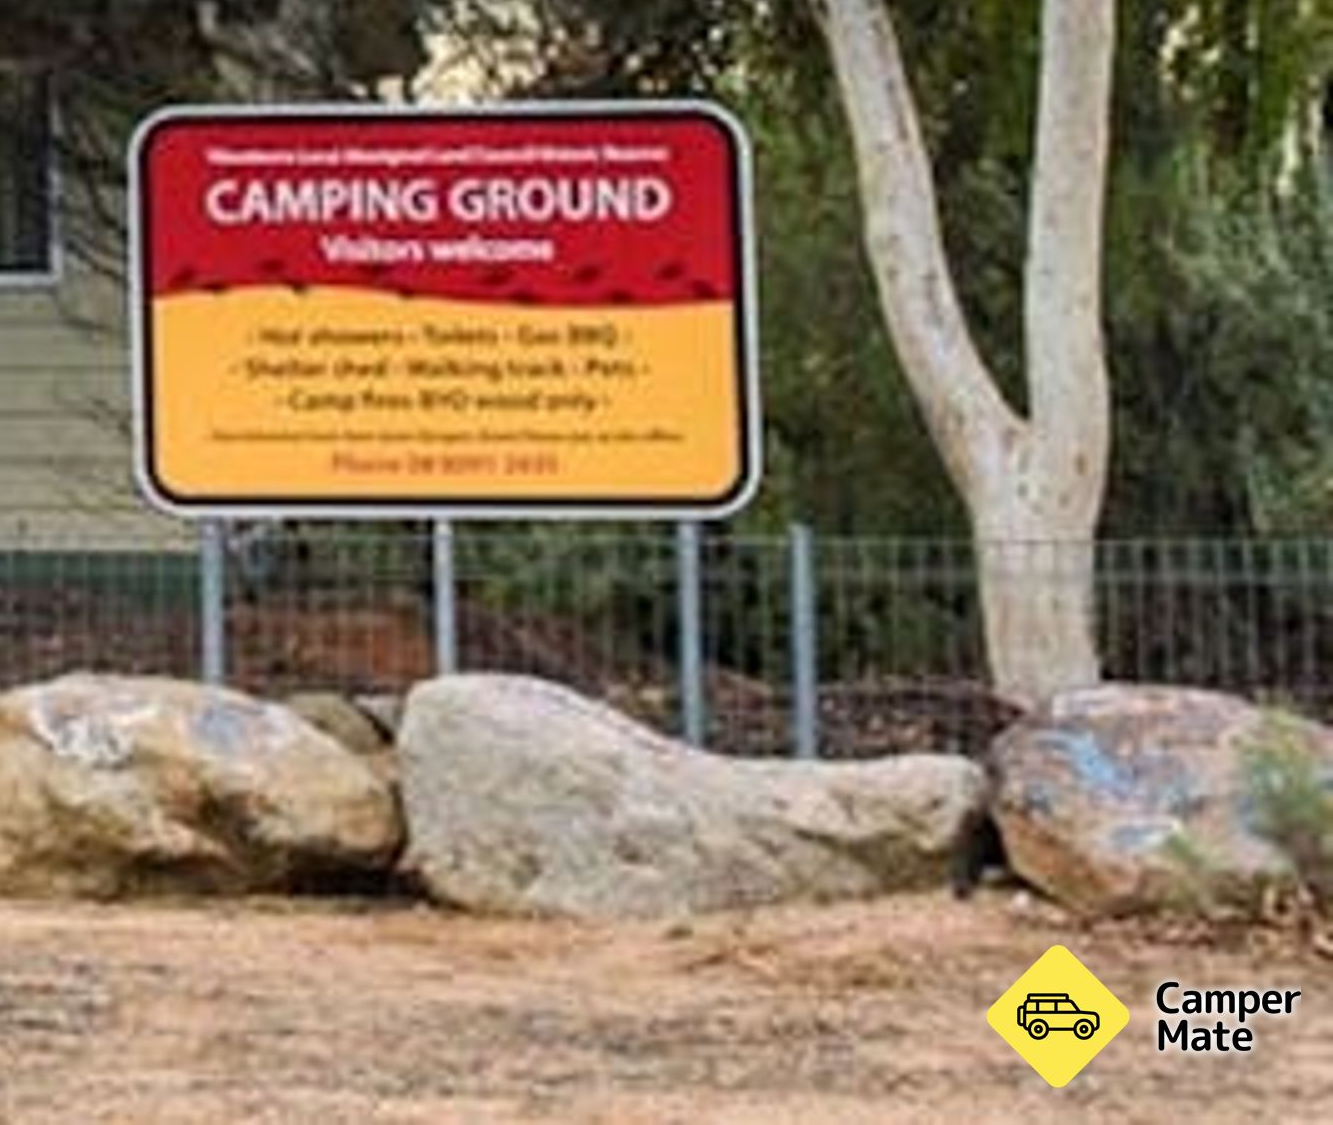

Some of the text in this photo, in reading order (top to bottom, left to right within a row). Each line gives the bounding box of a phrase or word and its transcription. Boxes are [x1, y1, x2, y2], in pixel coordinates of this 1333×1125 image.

[204, 177, 672, 224] CAMPING GROUND
[319, 234, 555, 263] Visitors welcome
[259, 328, 300, 347] Hot
[308, 327, 405, 347] showers
[424, 325, 499, 346] Toilets
[245, 357, 327, 379] Shelter
[333, 357, 388, 378] shed
[406, 358, 502, 383] Walking
[507, 358, 564, 378] track
[287, 389, 355, 414] Camp
[476, 389, 539, 410] wood
